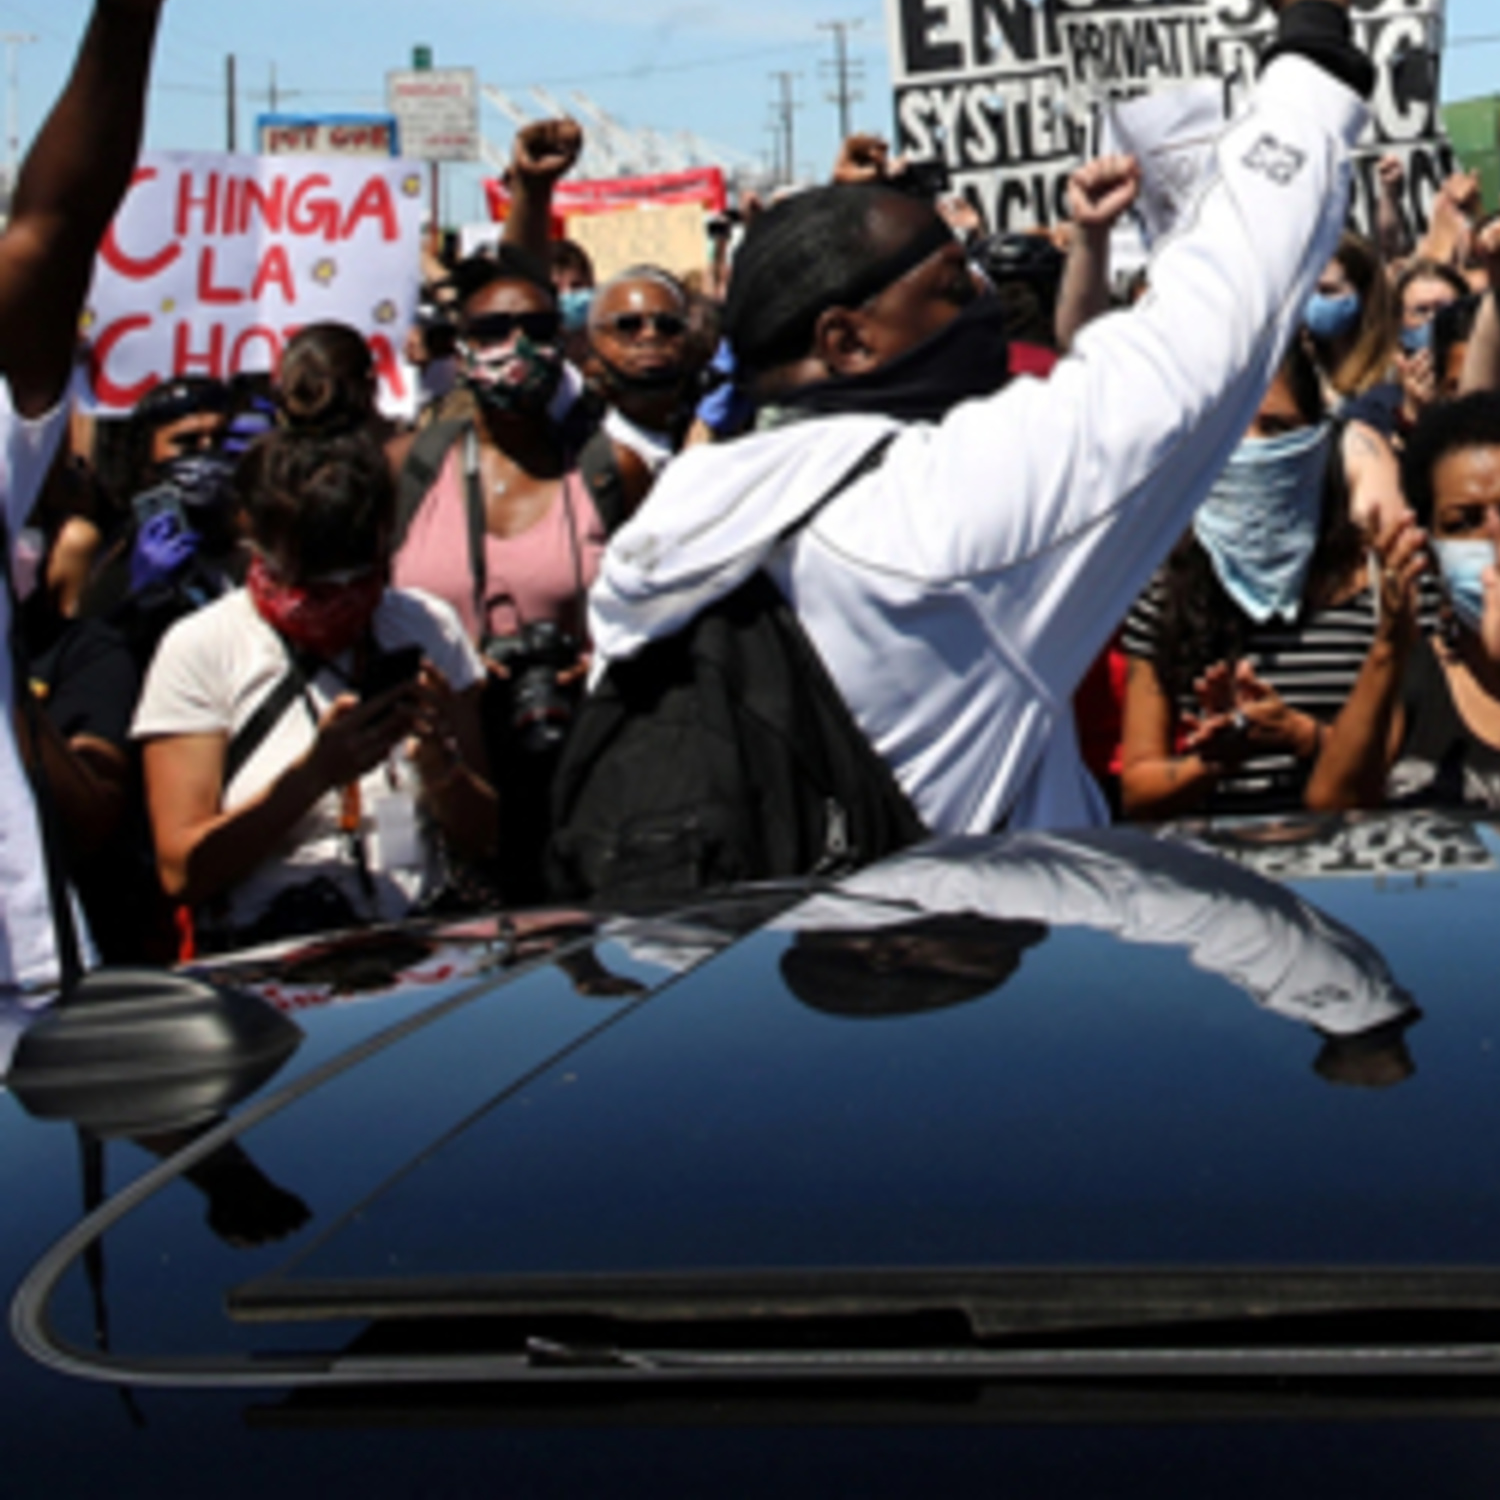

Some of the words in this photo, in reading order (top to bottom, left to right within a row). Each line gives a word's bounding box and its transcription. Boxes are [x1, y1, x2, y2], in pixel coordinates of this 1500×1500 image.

[1065, 14, 1208, 83] PRIVATI
[98, 165, 398, 282] CHINGA
[198, 244, 296, 305] LA
[90, 313, 405, 408] CHOA
